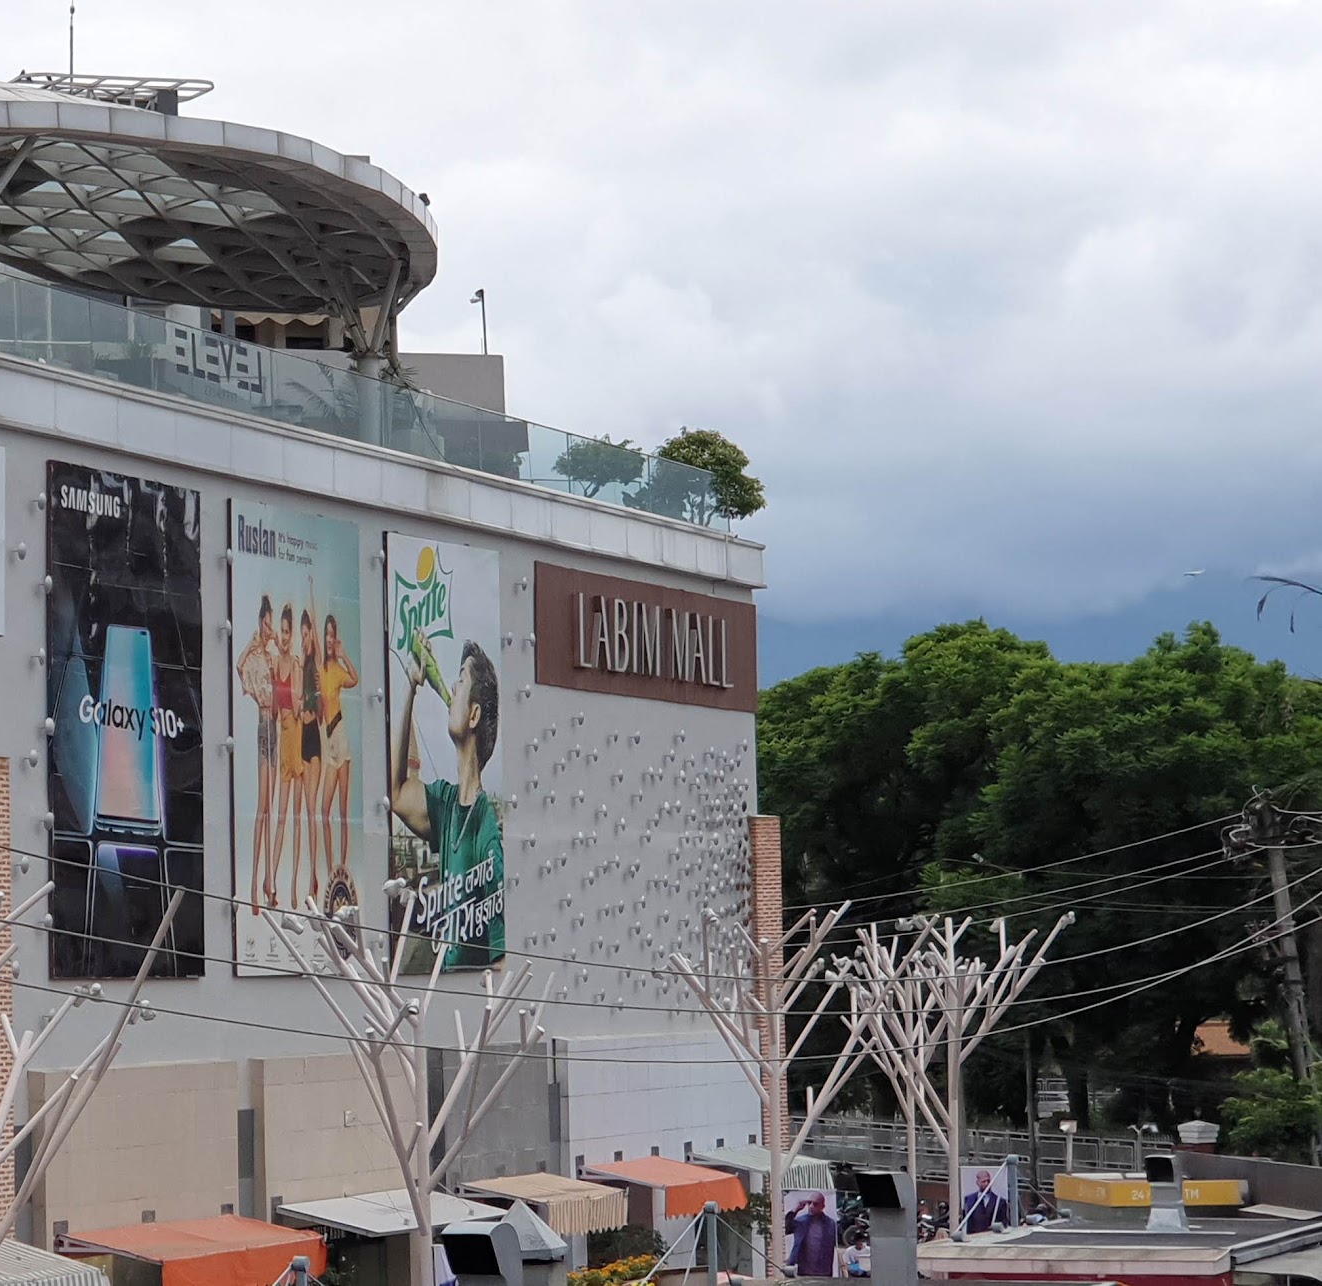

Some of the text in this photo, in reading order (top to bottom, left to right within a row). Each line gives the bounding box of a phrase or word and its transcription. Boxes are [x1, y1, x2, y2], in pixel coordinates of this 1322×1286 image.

[60, 484, 121, 519] SAMSUNG
[238, 514, 276, 559] Ruslan
[397, 571, 447, 656] Sprite
[577, 592, 734, 688] LABIM MALL
[79, 695, 185, 741] Galaxy S10+
[417, 869, 463, 932] Sprite
